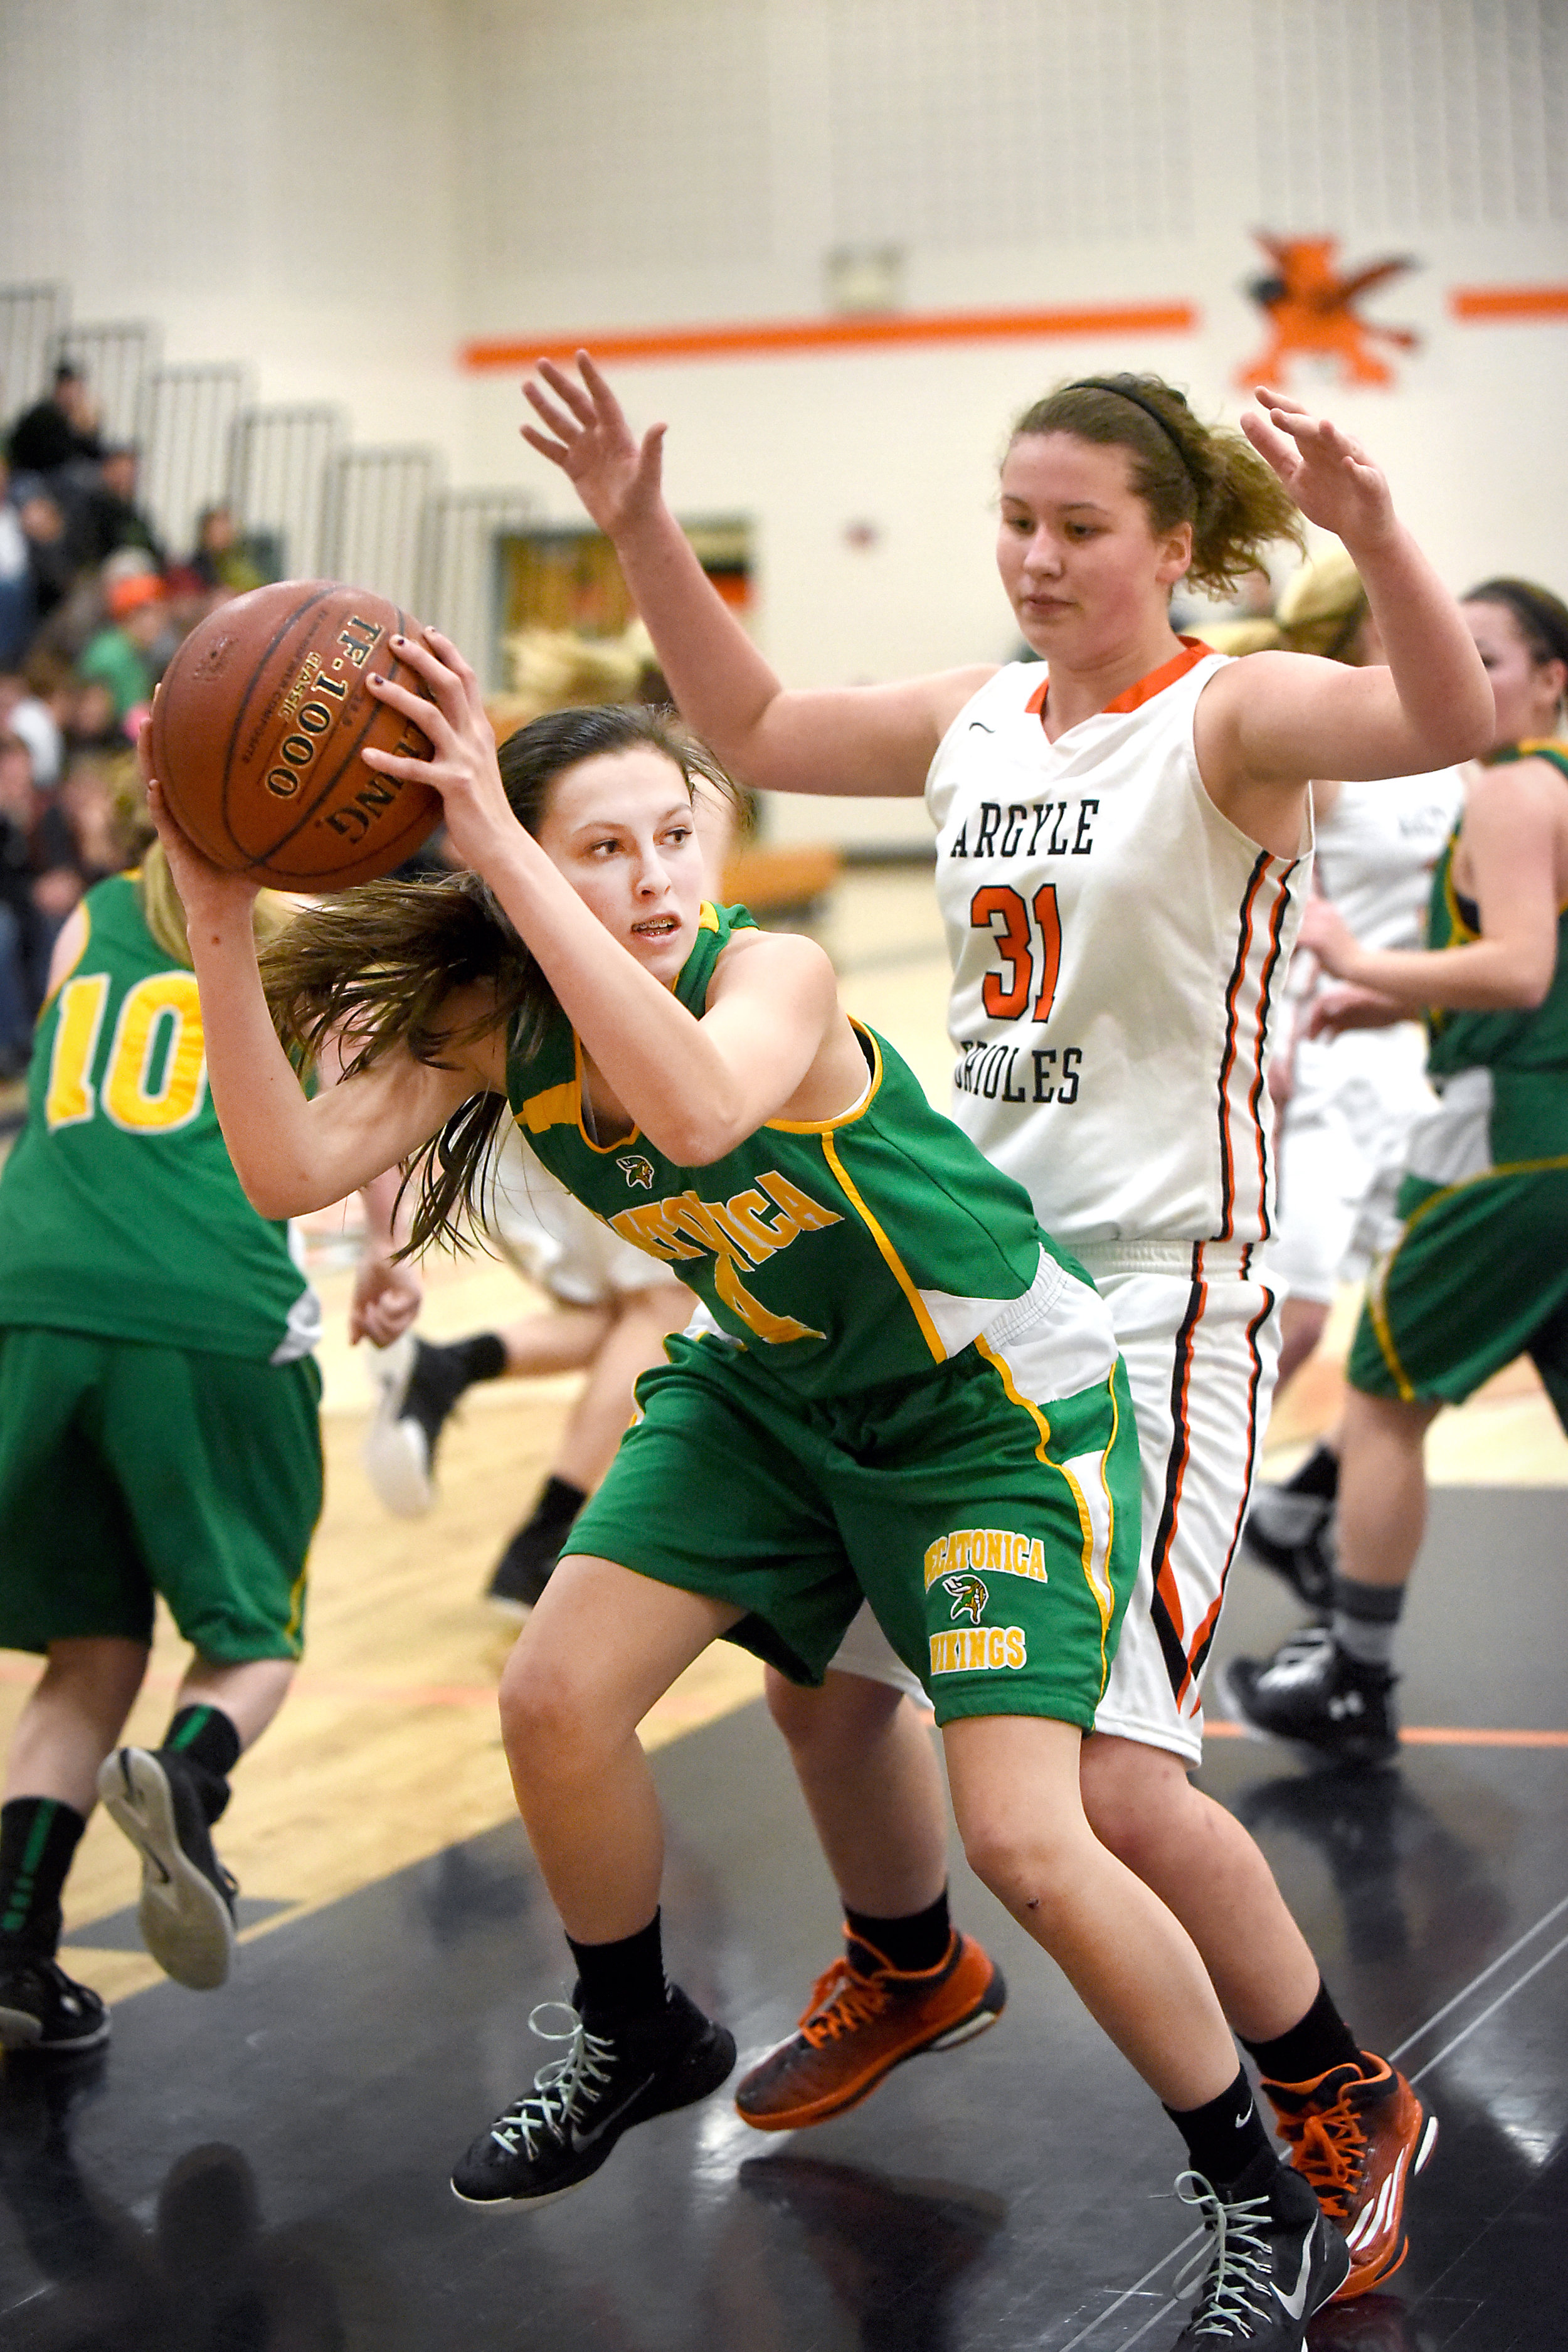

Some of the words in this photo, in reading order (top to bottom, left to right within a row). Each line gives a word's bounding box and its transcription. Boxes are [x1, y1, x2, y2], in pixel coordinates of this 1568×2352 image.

[264, 615, 385, 799] TF-1000
[278, 650, 322, 723] CLASSIC
[950, 799, 1099, 858] ARGYLE
[970, 883, 1062, 1023] 31
[45, 970, 208, 1134] 10
